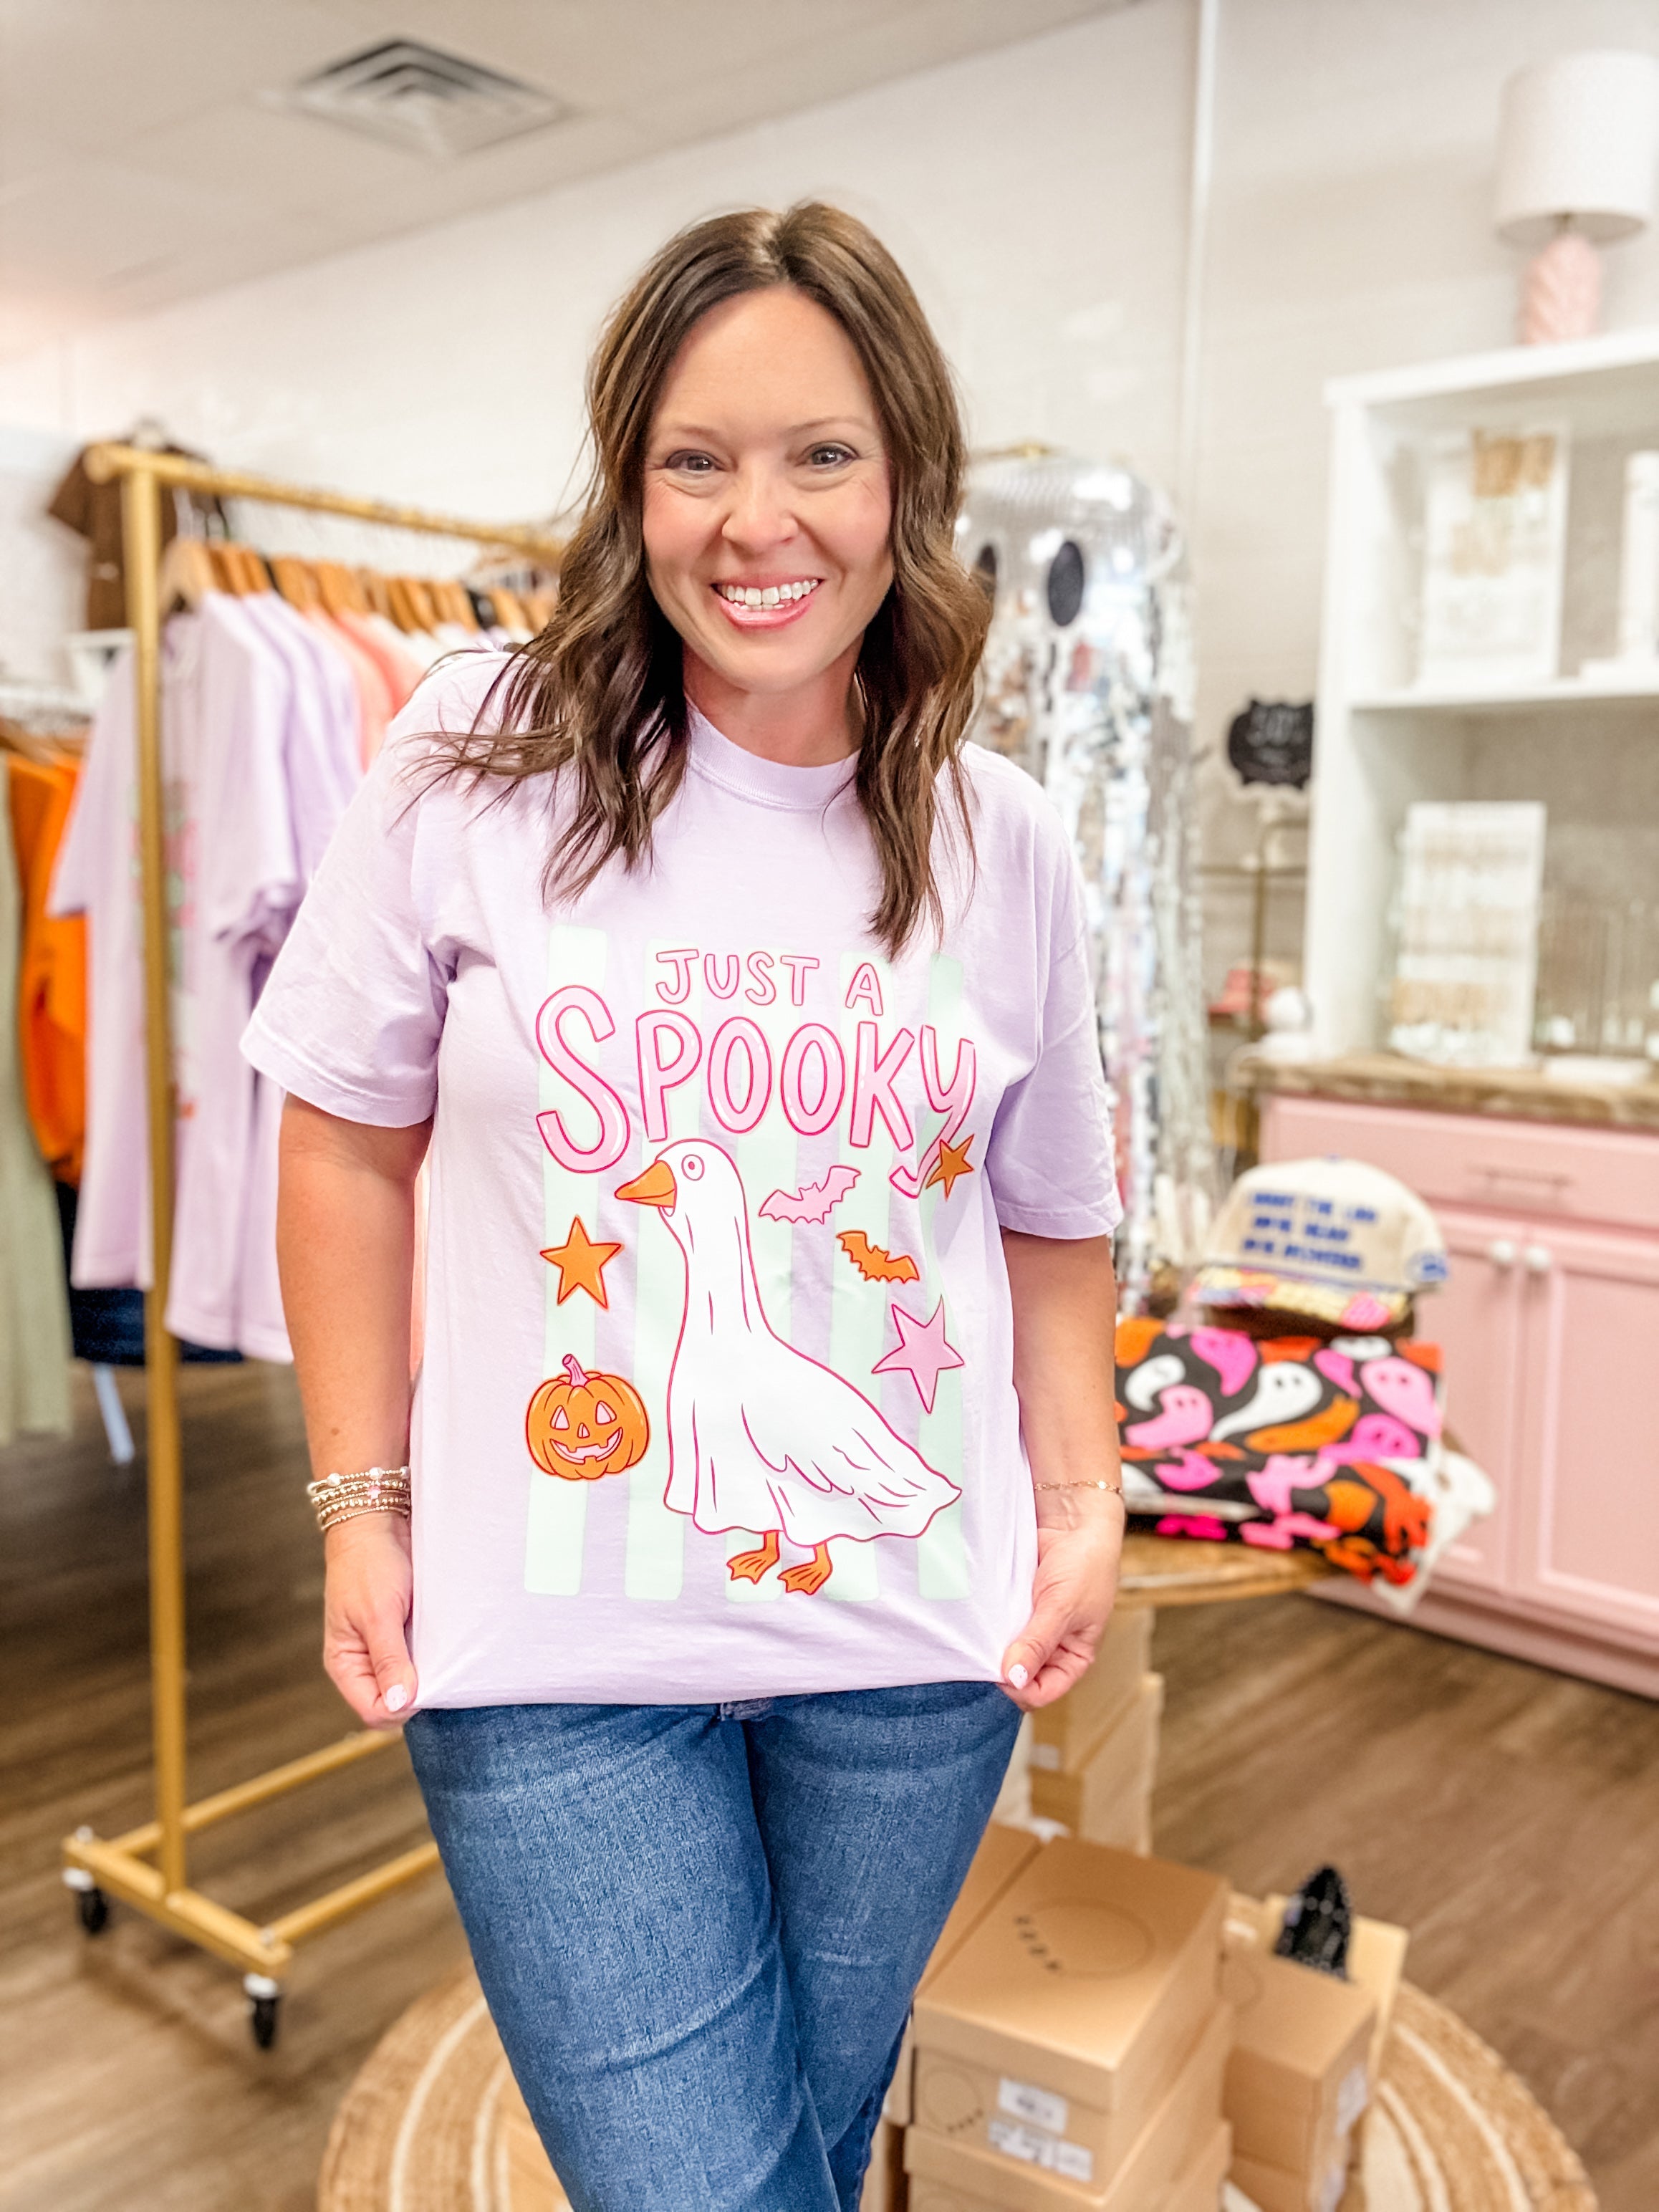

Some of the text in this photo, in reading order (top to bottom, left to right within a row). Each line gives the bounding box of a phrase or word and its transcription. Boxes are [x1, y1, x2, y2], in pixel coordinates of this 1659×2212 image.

[655, 948, 884, 1016] JUST A
[535, 984, 976, 1199] SPOOKY
